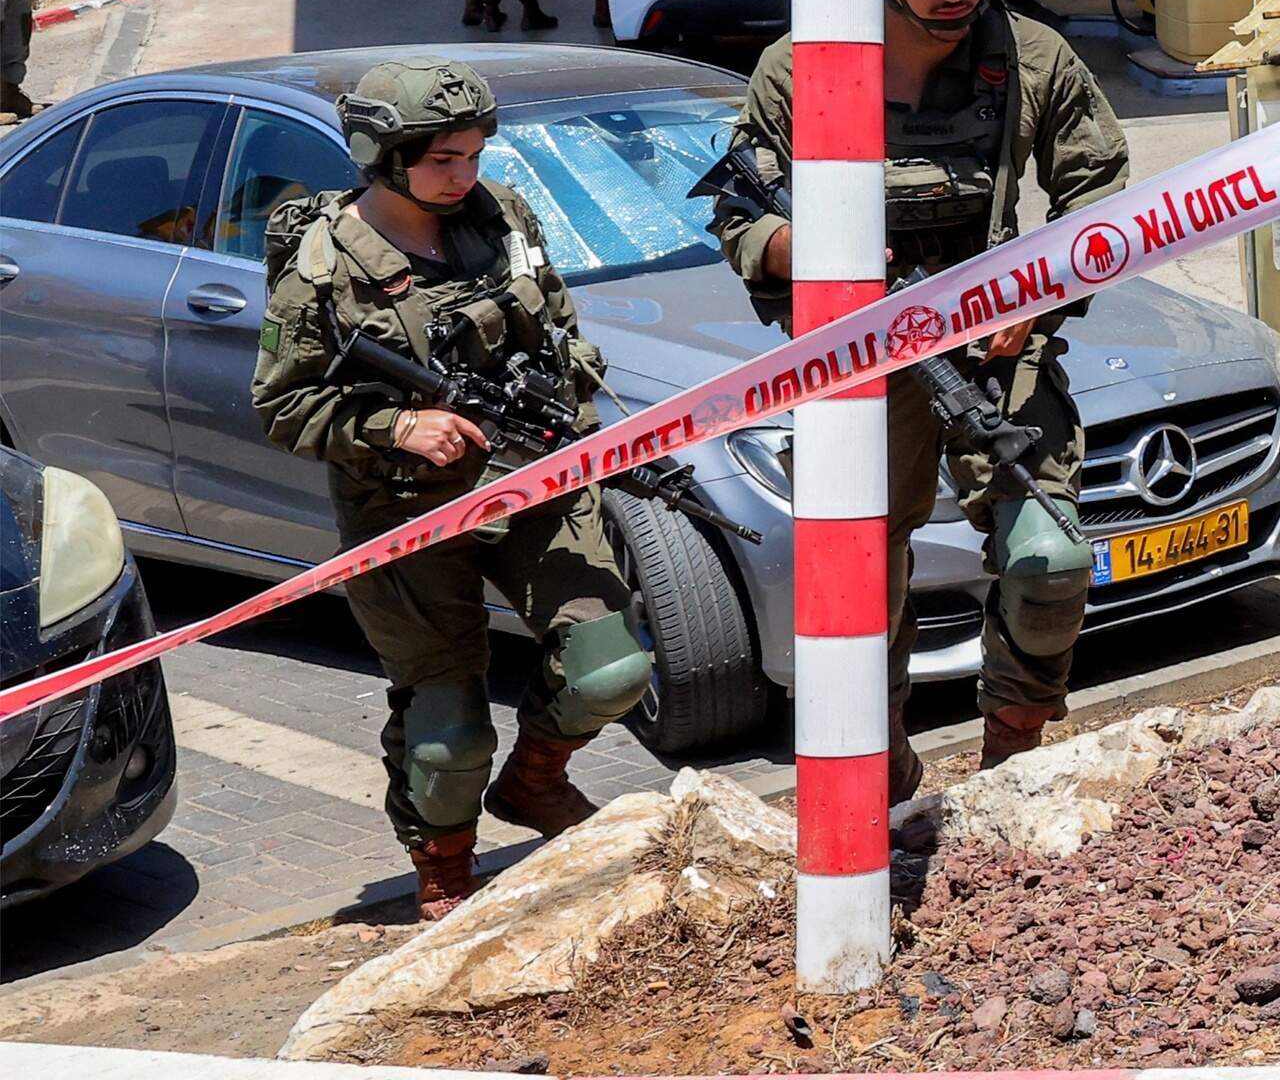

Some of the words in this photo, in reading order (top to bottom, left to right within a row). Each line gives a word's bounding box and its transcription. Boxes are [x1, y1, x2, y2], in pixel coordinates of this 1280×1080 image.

[1135, 192, 1184, 254] אין
[1185, 166, 1276, 231] מעבר
[744, 332, 877, 420] משטרת
[953, 258, 1066, 335] ישראל
